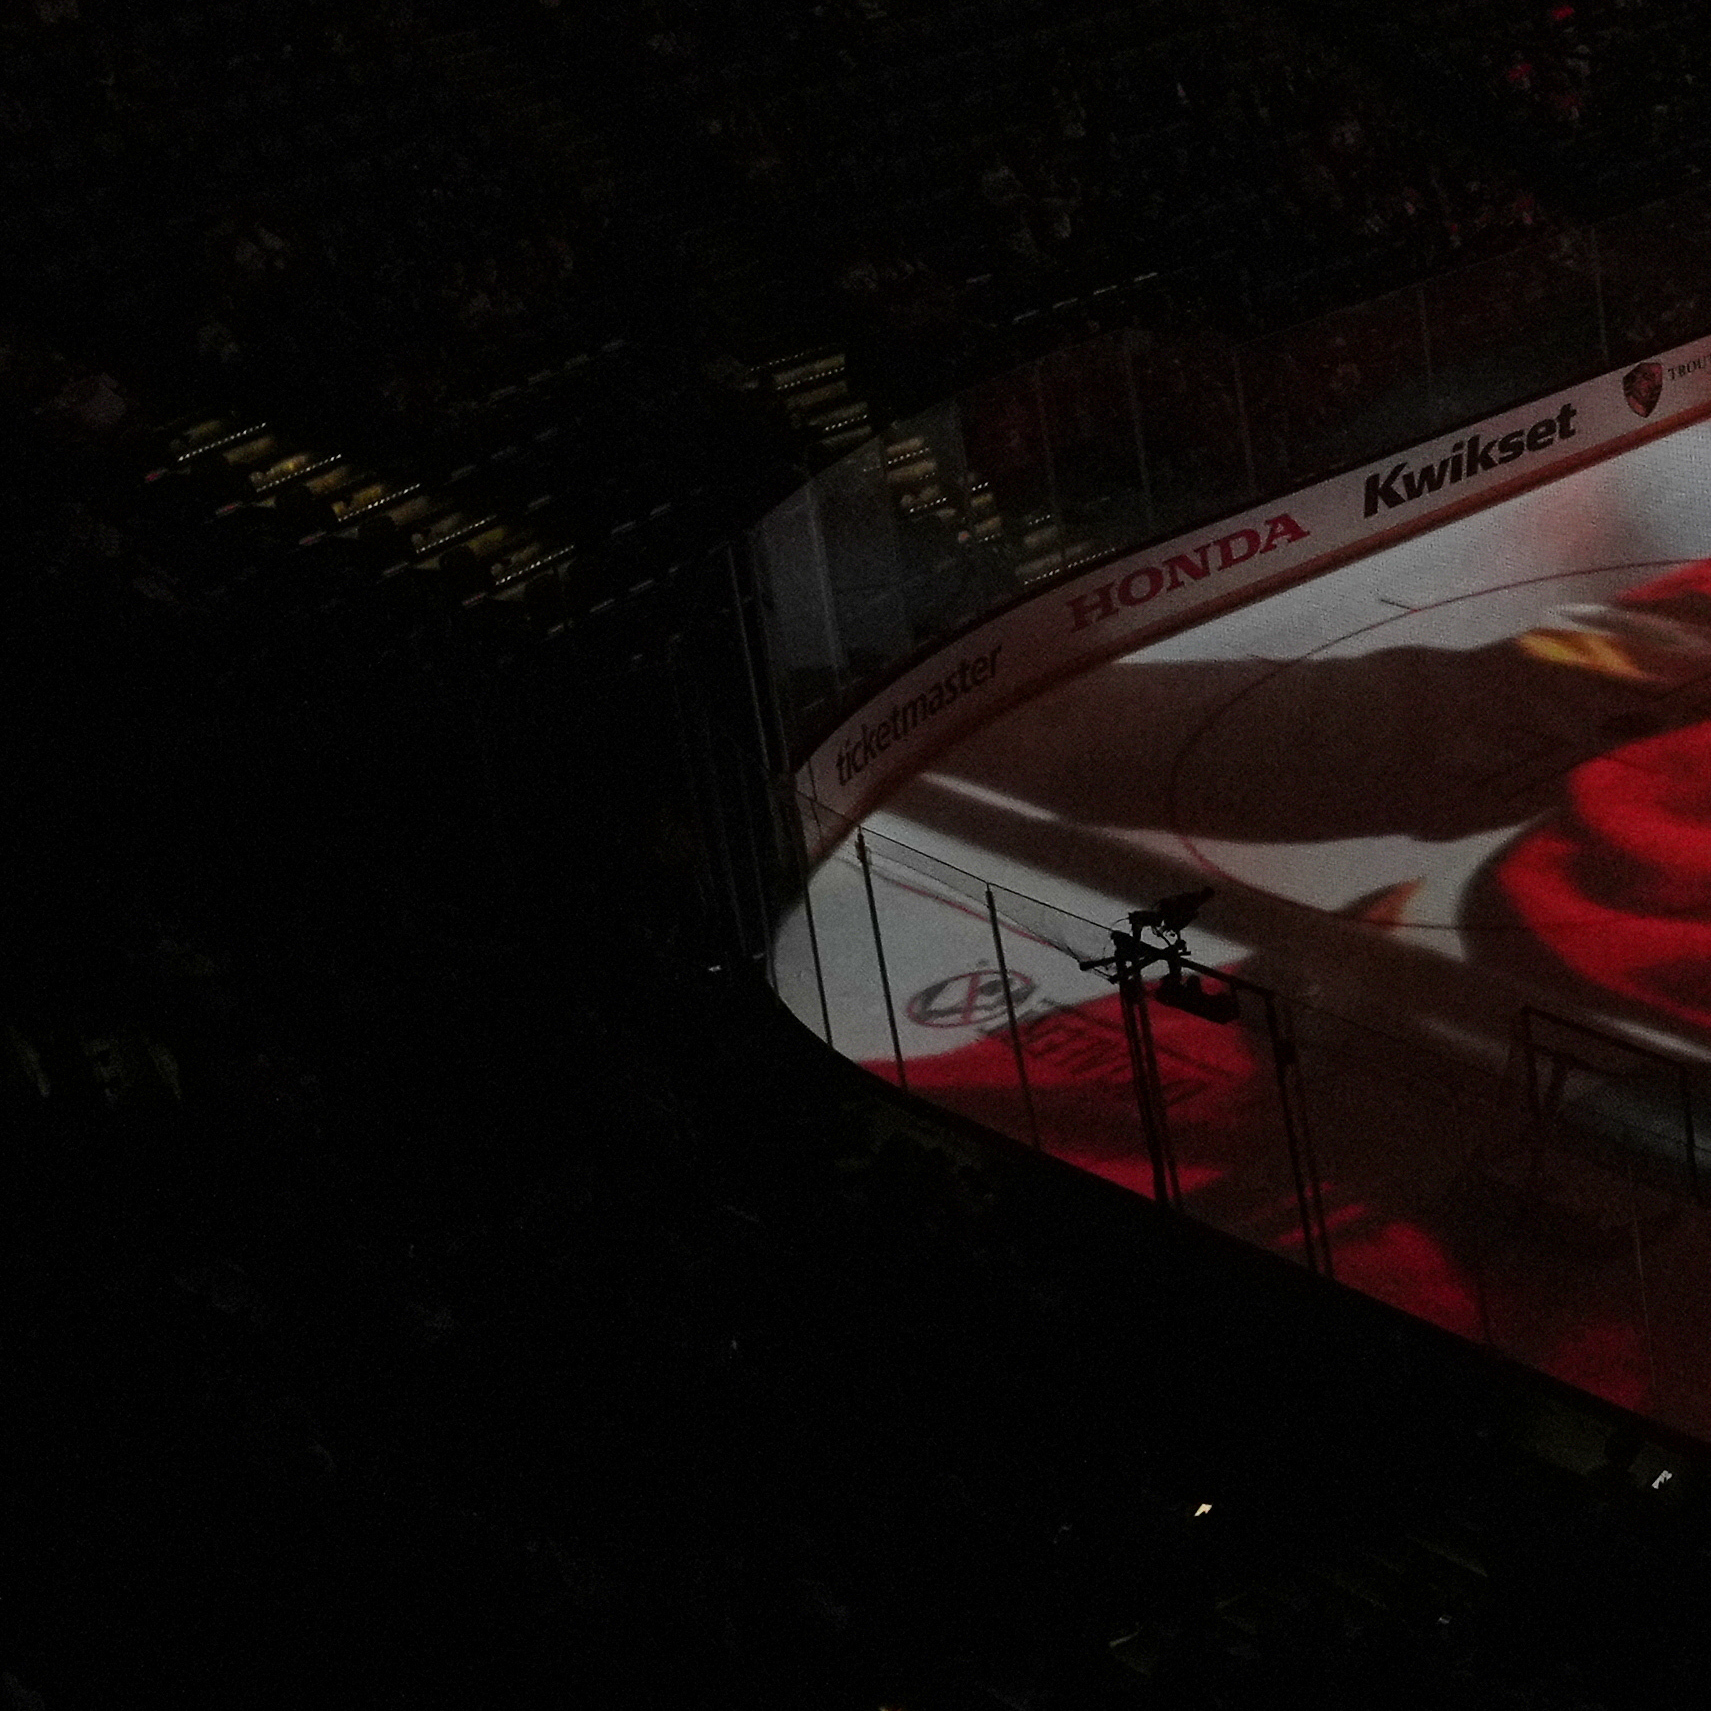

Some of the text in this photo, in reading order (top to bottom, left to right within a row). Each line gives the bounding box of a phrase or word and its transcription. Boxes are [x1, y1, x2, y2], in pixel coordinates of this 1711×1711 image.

[1364, 403, 1578, 519] Kwikset
[1066, 512, 1311, 633] HONDA
[836, 643, 1003, 787] ticketmaster
